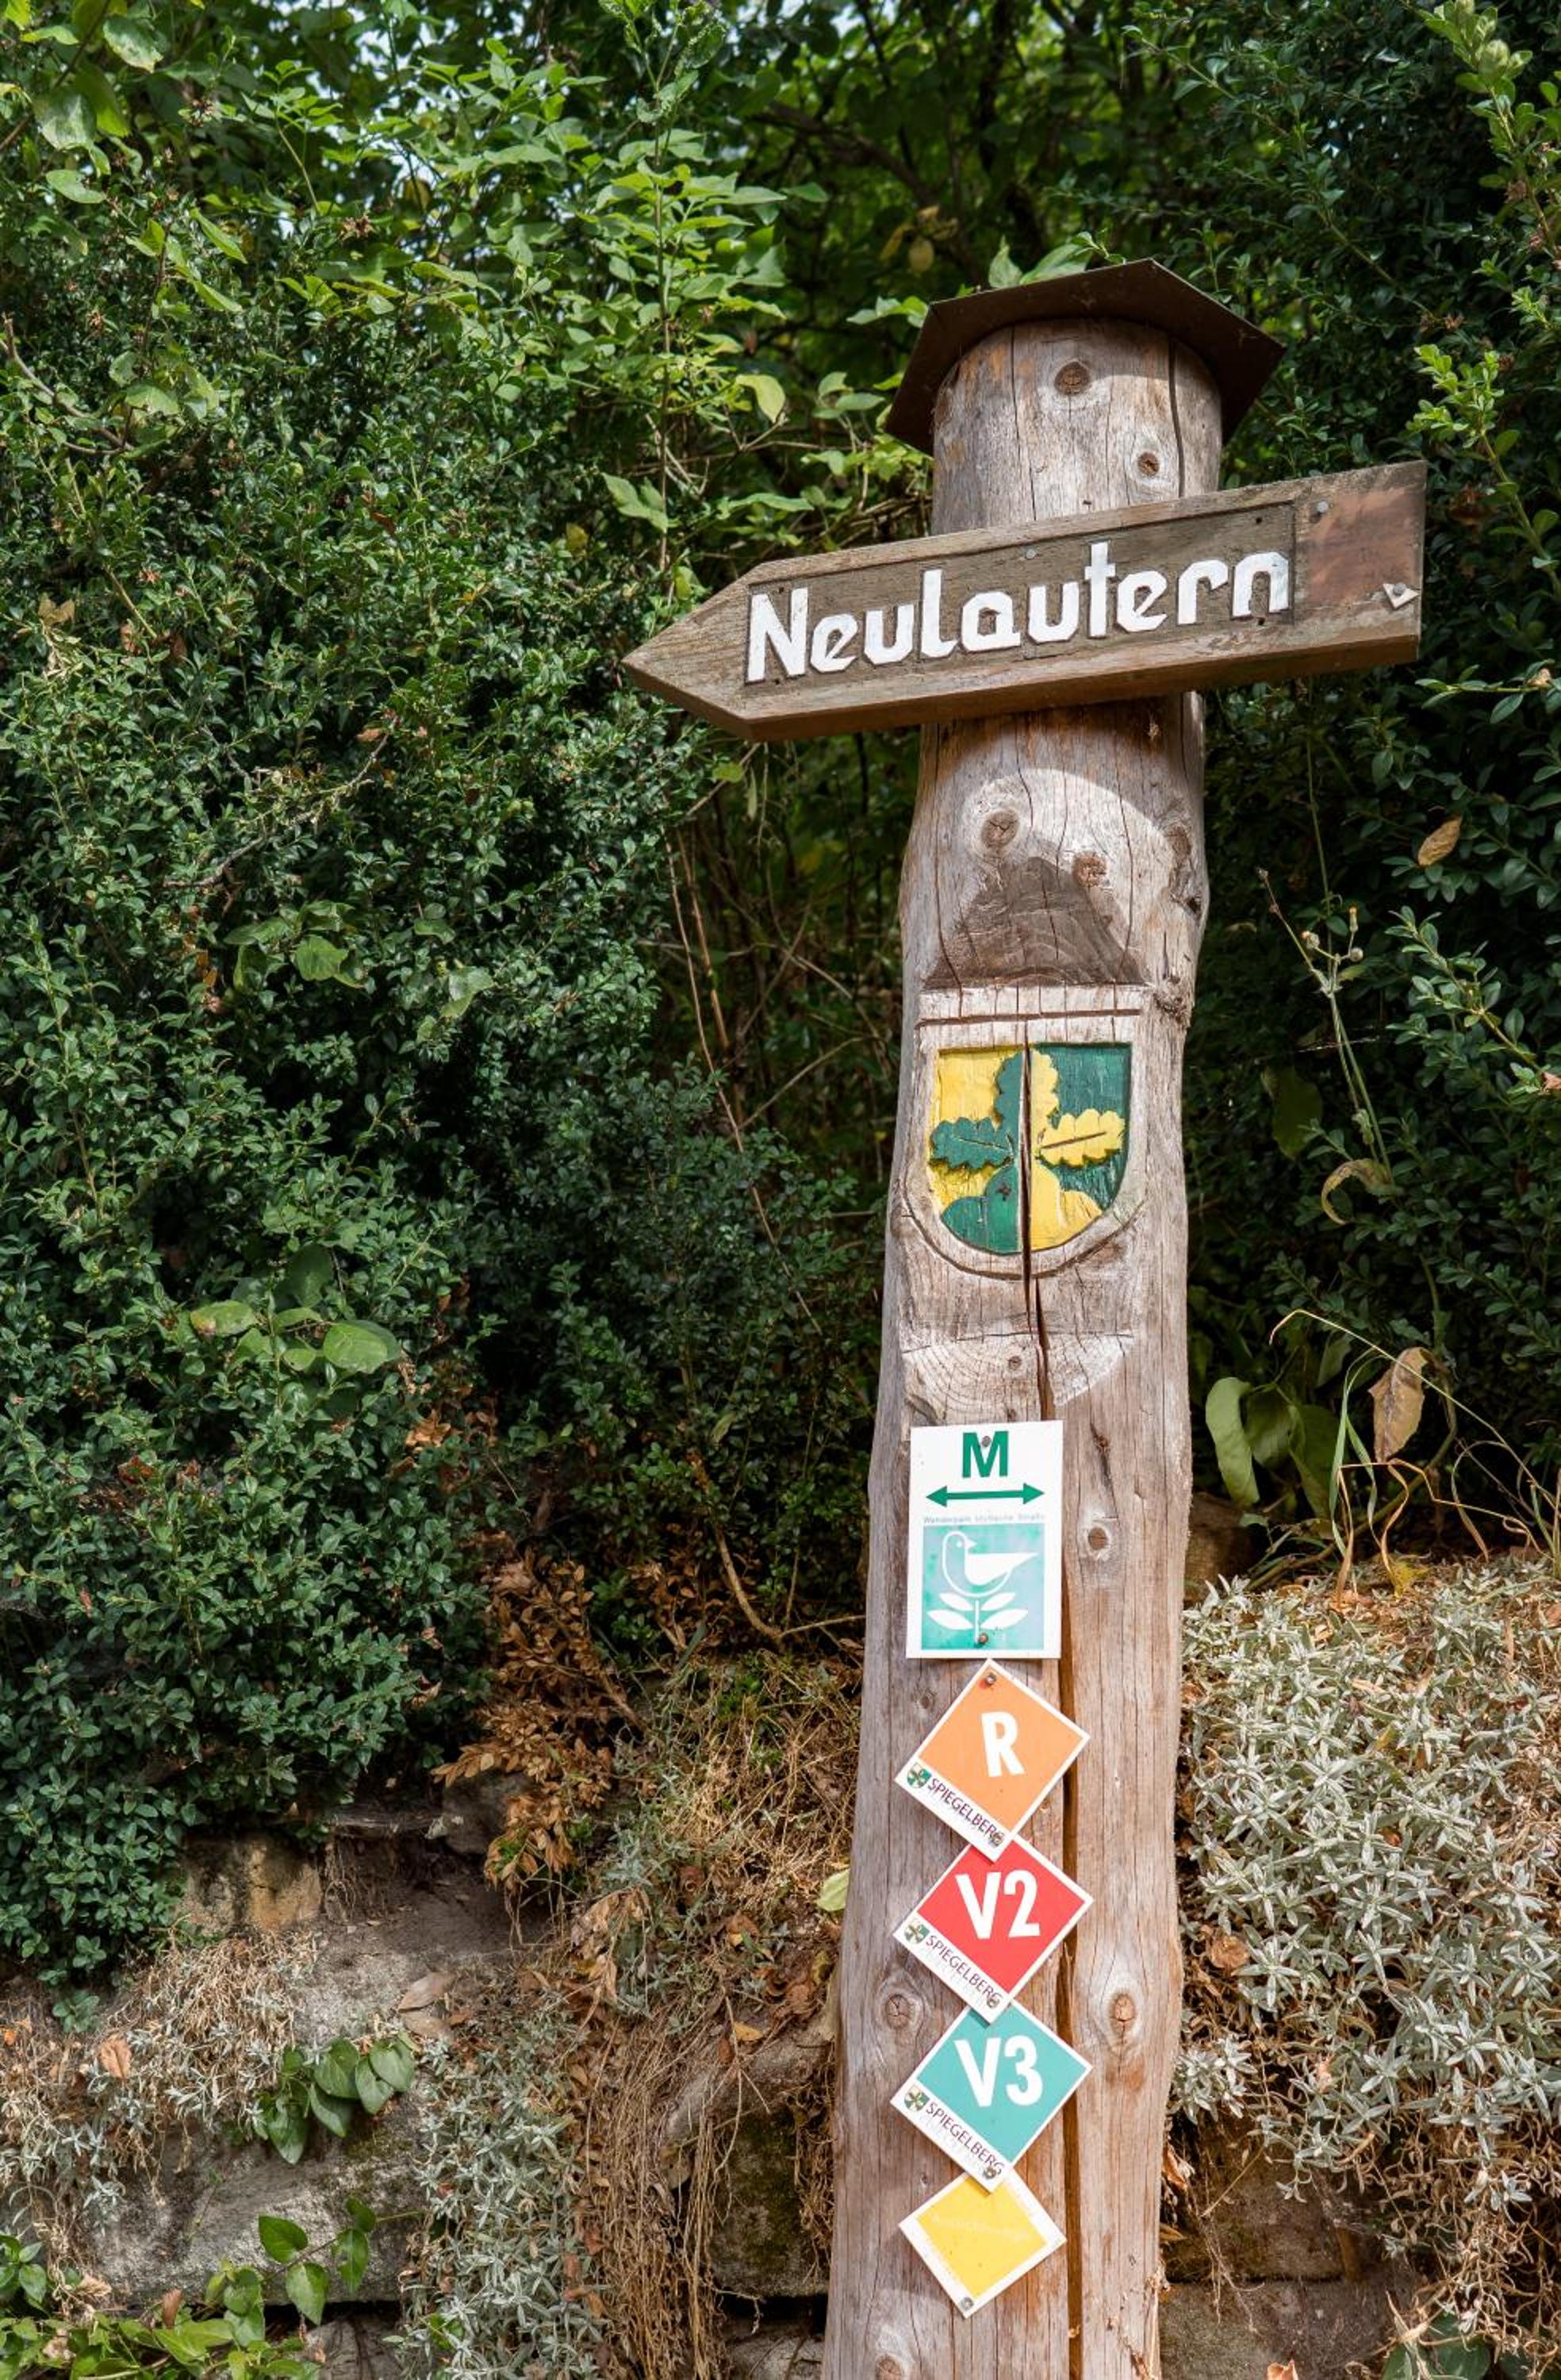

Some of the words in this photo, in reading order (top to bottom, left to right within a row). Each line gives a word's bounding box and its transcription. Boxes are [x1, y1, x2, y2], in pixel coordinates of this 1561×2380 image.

[746, 541, 1289, 682] Neulautern
[962, 1431, 1009, 1478] M
[981, 1711, 1025, 1777] R
[927, 1778, 1005, 1847] SPIEGELBER
[955, 1869, 1041, 1939] V2
[955, 2035, 1042, 2107] V3
[926, 2102, 1004, 2175] SPIEGELBERG
